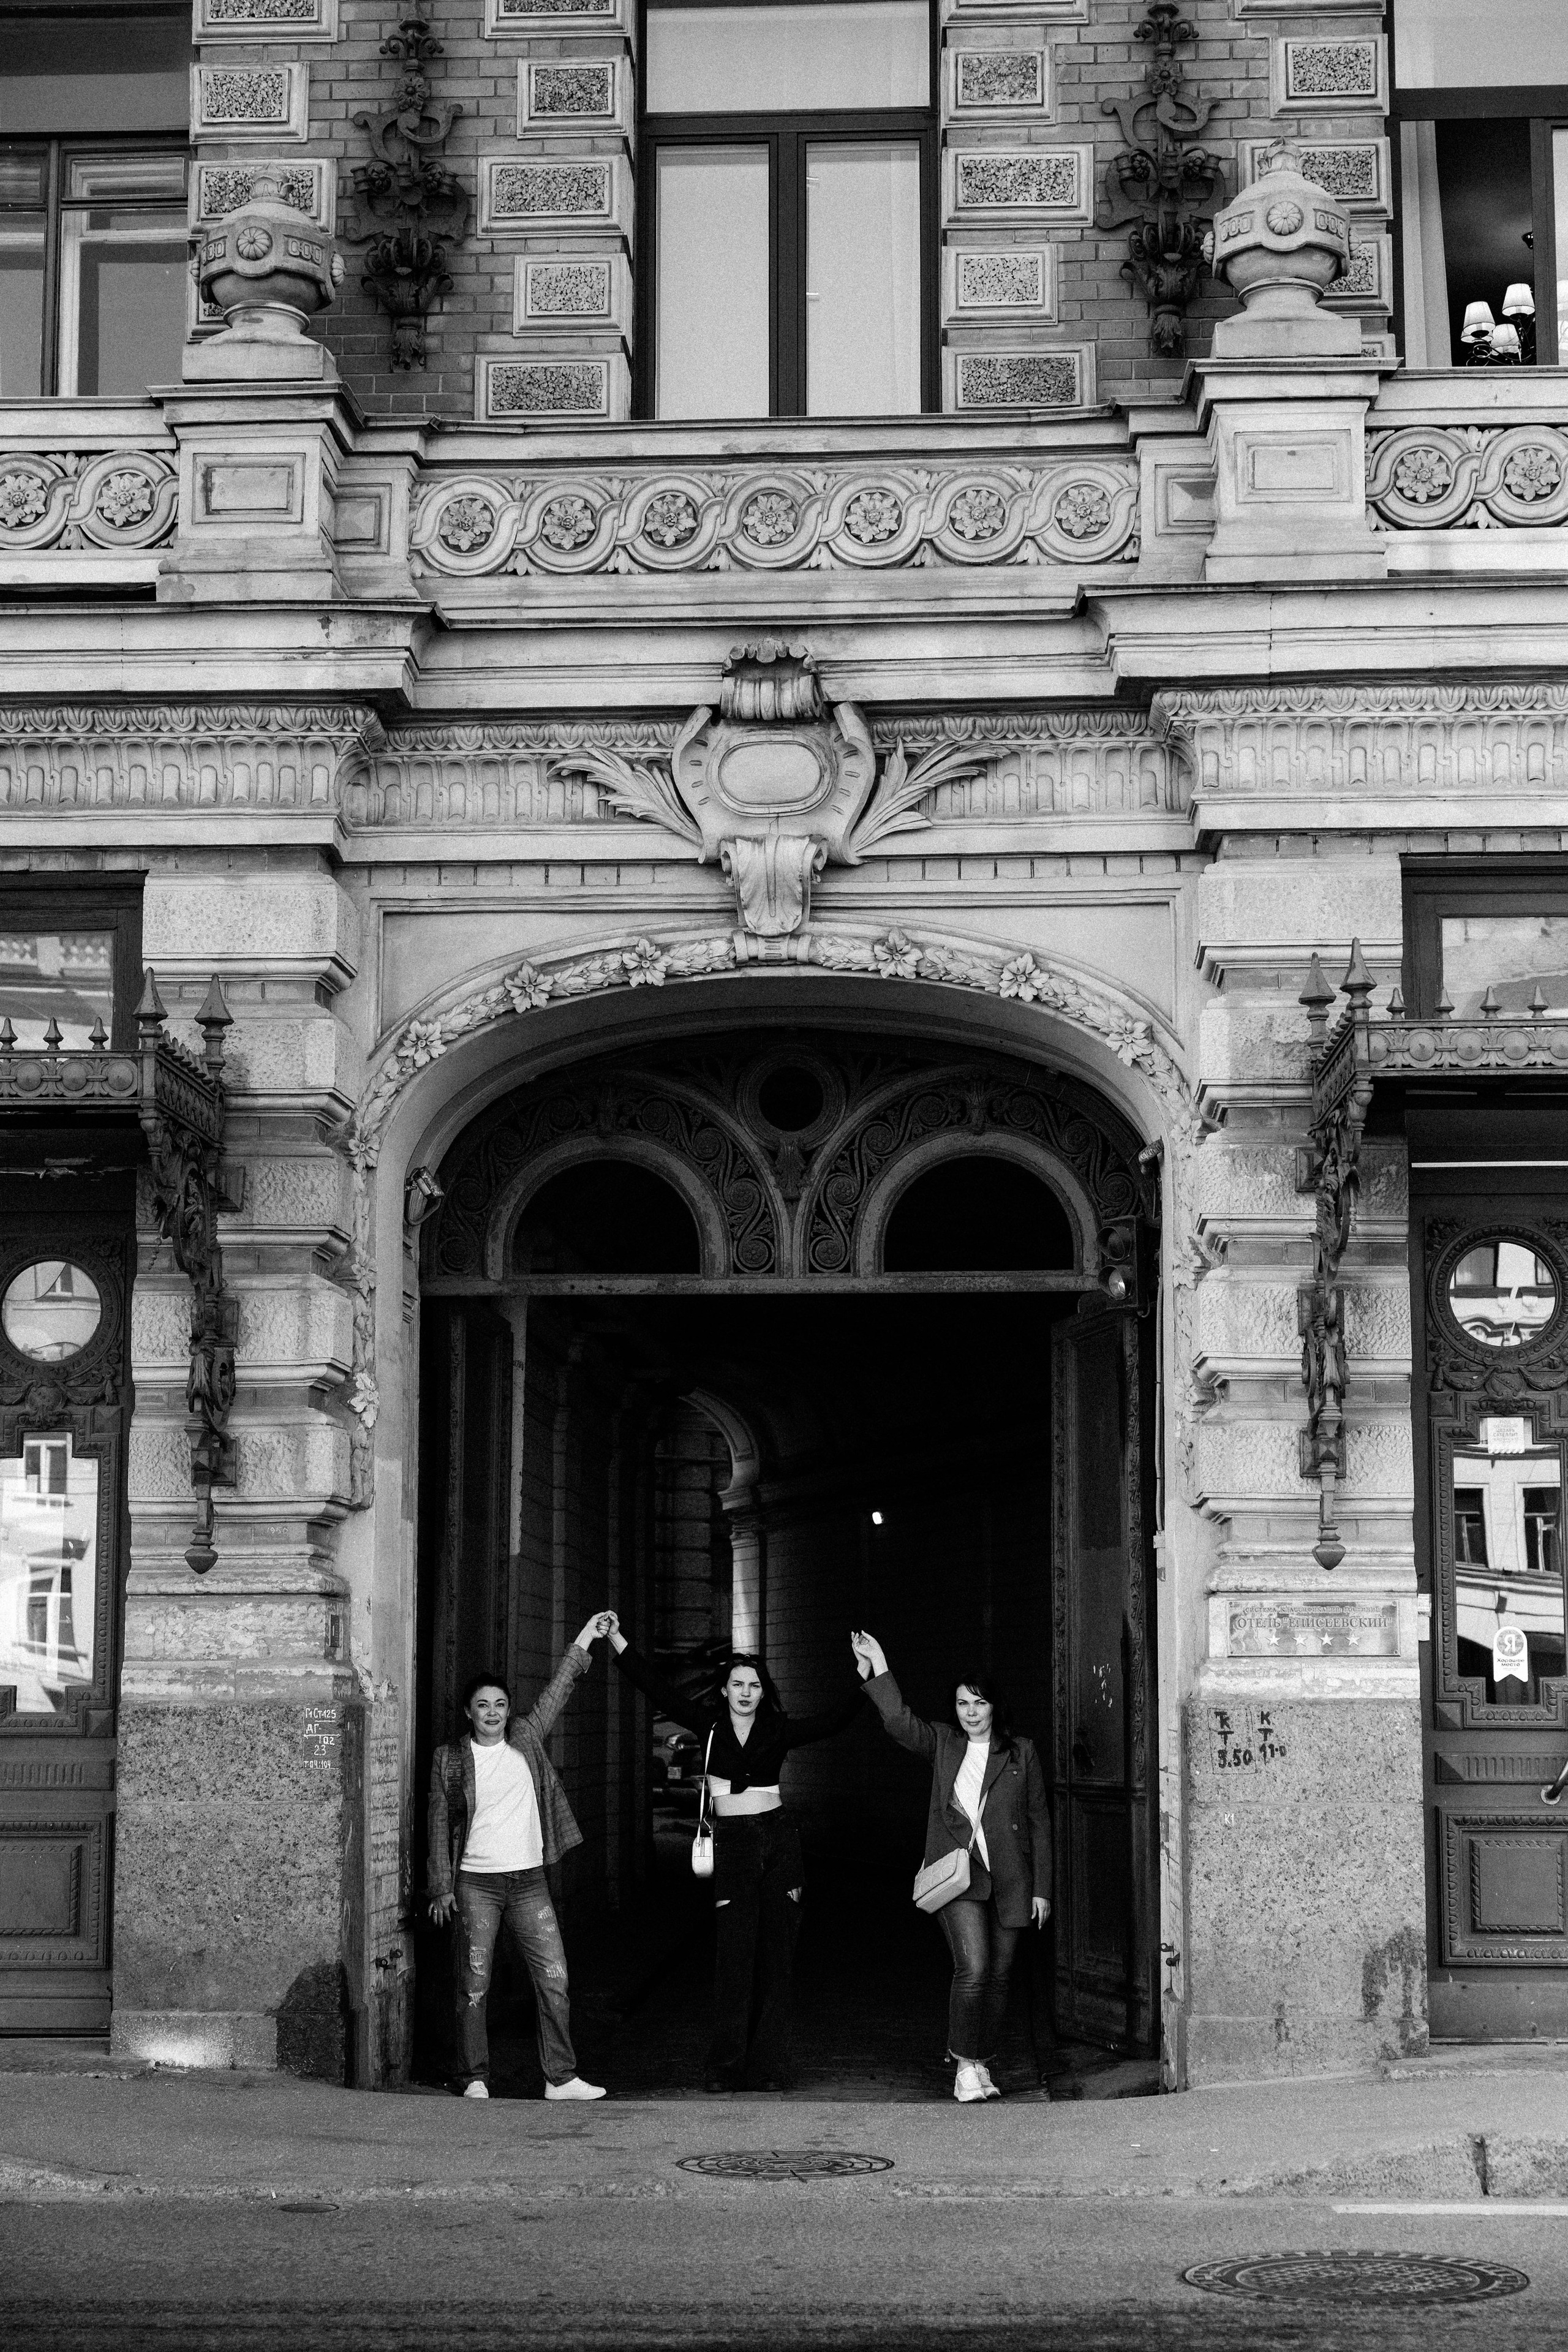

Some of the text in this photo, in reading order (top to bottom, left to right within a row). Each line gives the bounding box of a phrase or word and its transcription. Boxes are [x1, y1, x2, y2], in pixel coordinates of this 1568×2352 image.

[1237, 1615, 1392, 1628] ОТЕЛЬ "ЕЛИСЕЕВСКИЙ"
[1504, 1634, 1516, 1652] Я
